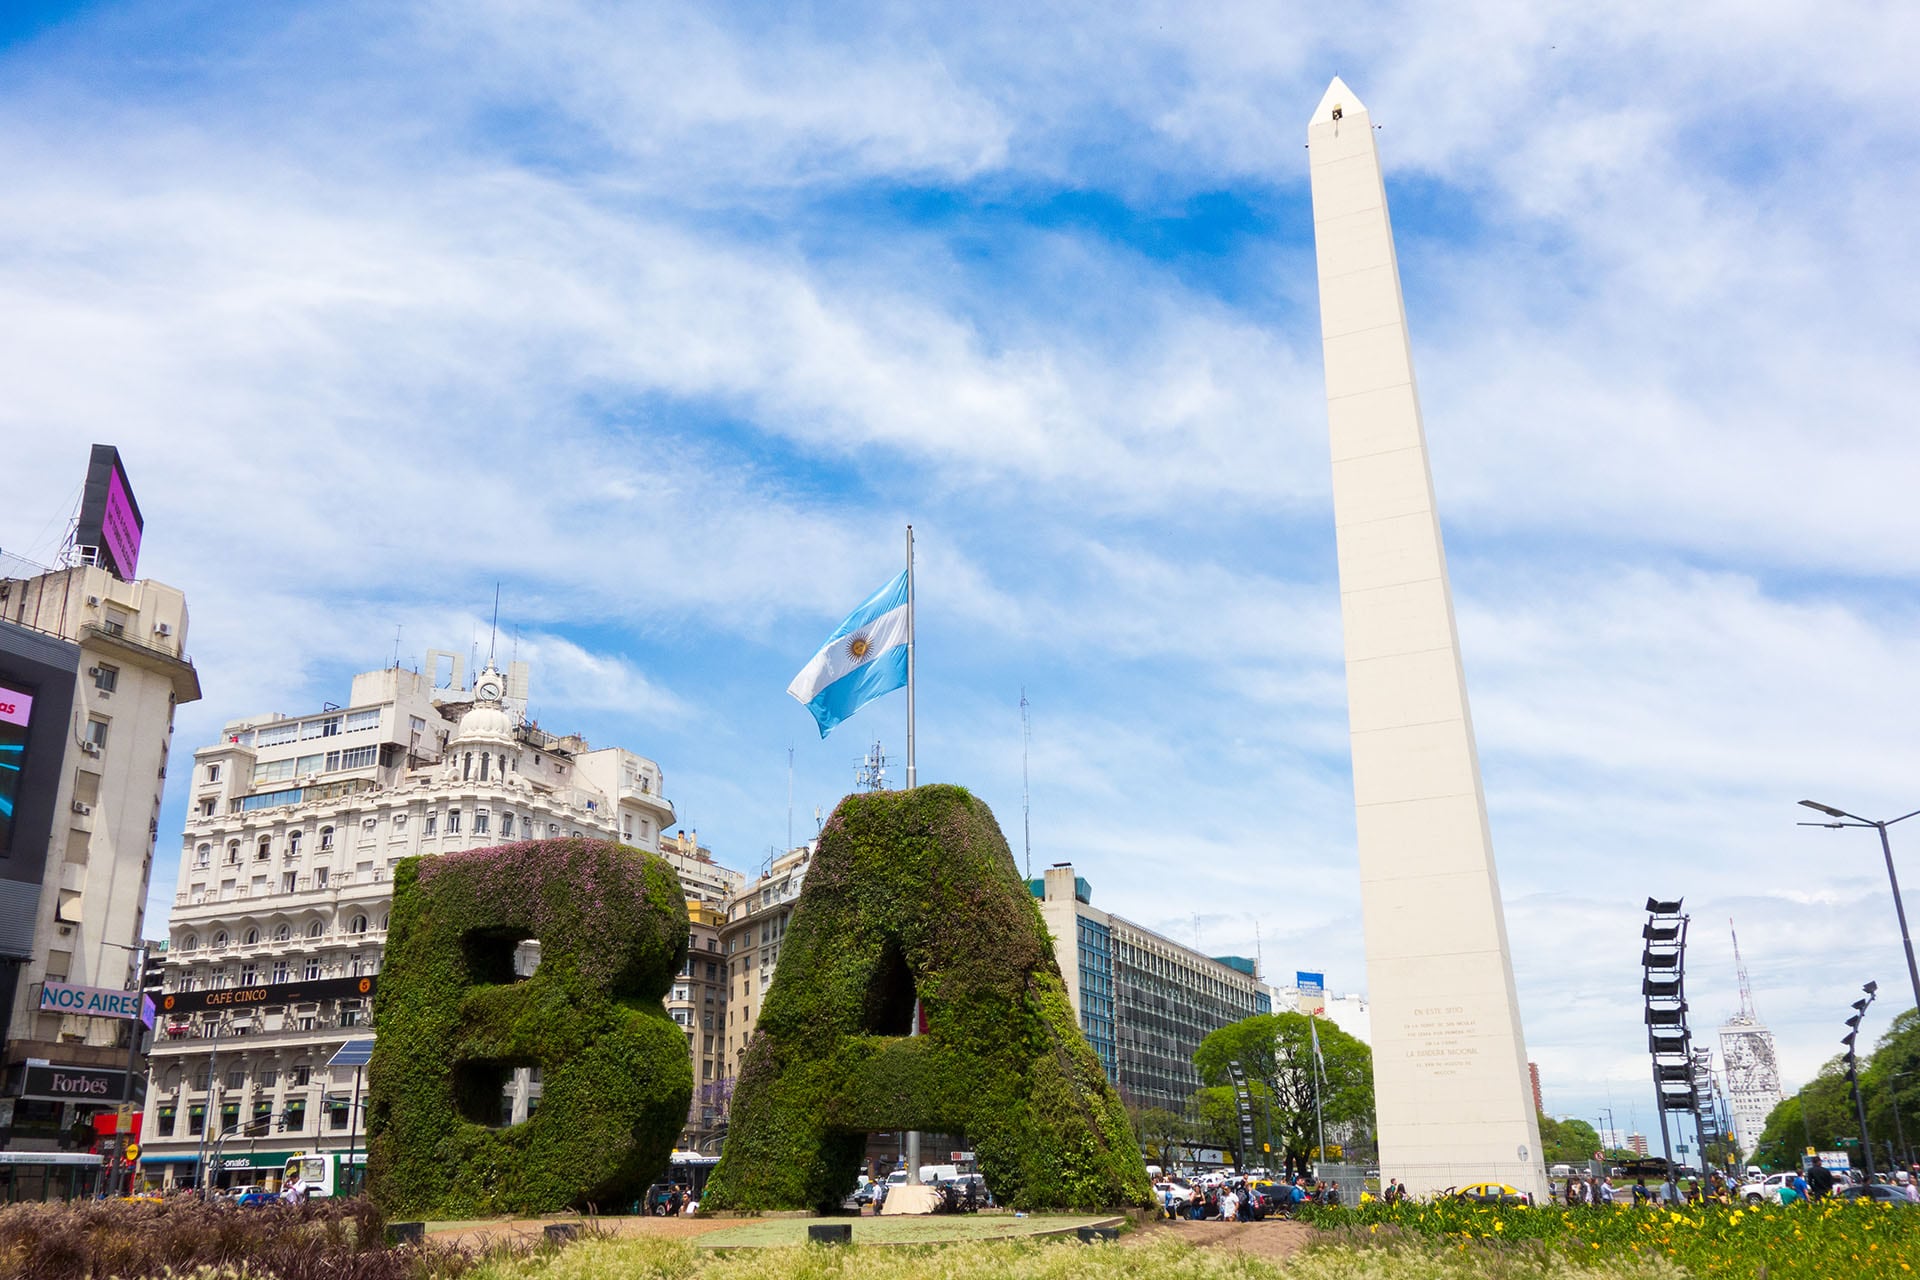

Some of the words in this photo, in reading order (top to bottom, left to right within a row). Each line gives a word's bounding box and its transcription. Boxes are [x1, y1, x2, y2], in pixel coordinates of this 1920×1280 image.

[41, 986, 86, 1009] NOS
[88, 993, 140, 1015] AIRES
[206, 990, 233, 1005] CAFÉ
[235, 989, 267, 1002] CINCO
[51, 1073, 108, 1094] Forbes
[209, 1158, 250, 1168] onald's
